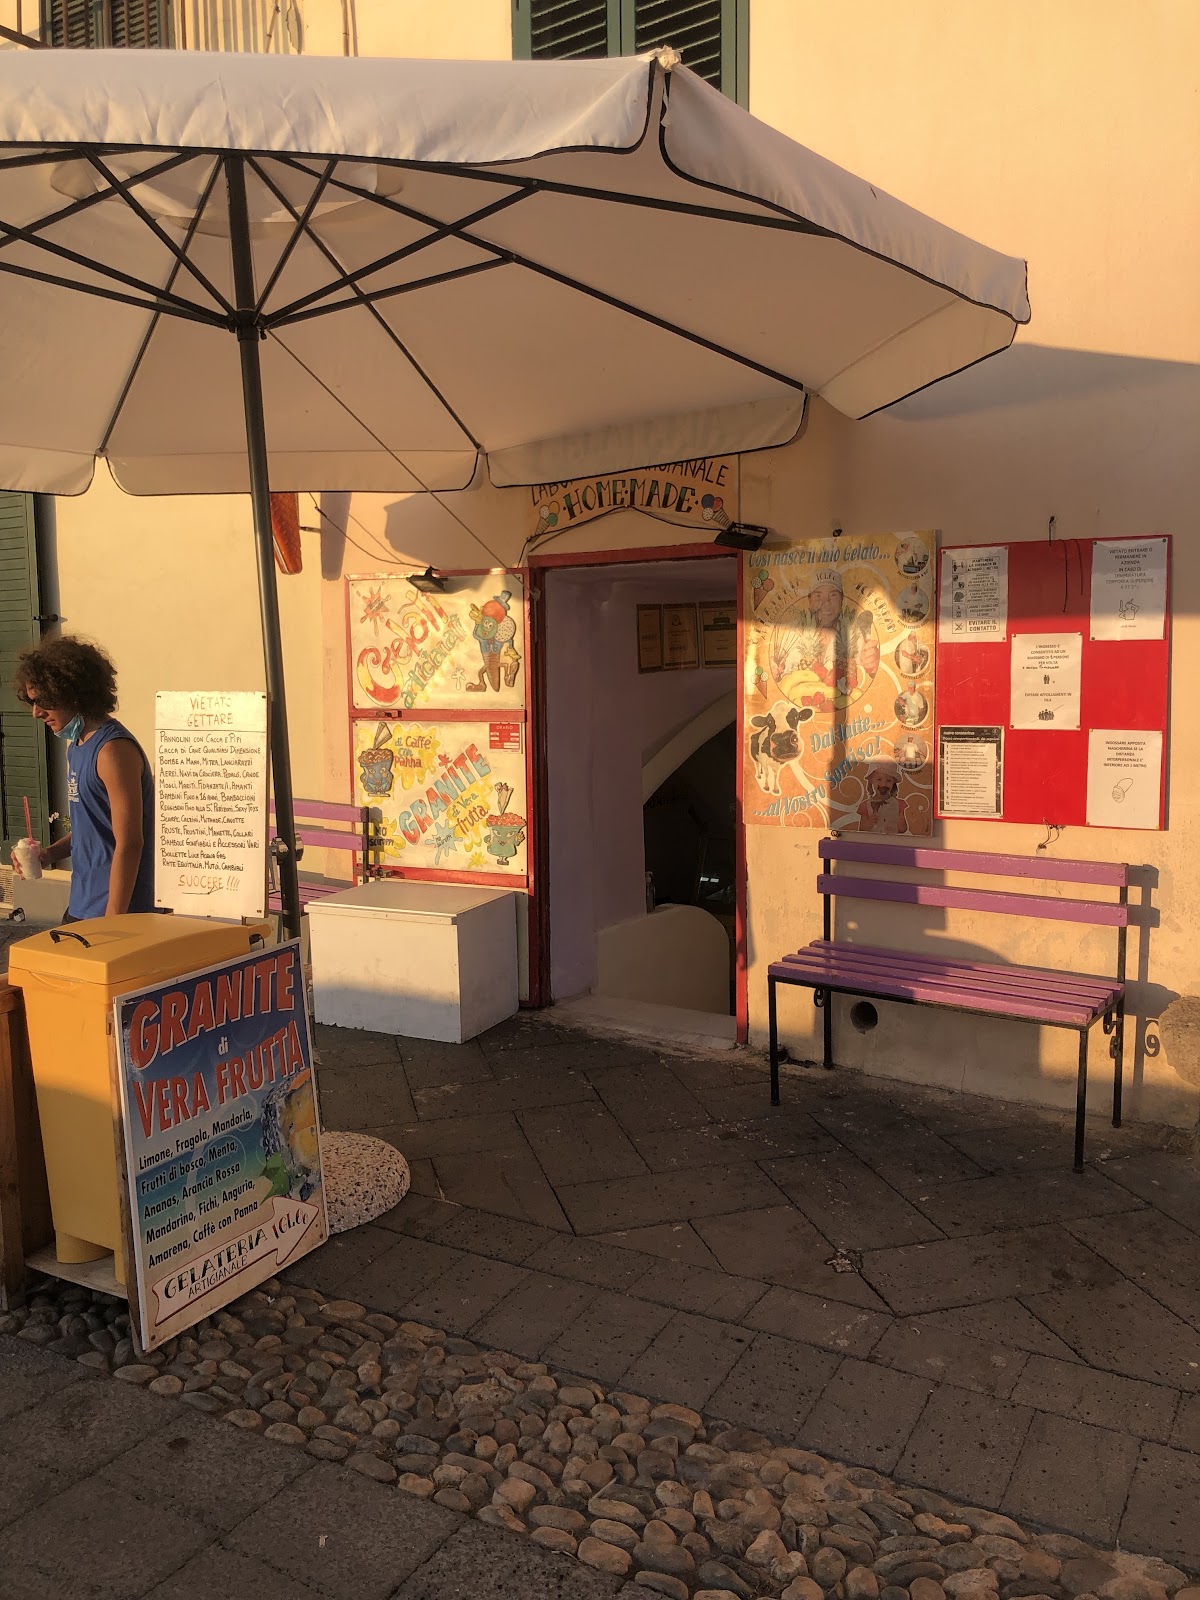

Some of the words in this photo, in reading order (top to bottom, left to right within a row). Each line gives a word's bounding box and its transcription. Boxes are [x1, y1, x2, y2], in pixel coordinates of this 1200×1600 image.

[819, 546, 840, 563] mio
[187, 713, 233, 727] GETTARE
[810, 726, 836, 753] Dal
[200, 793, 206, 801] 16
[399, 744, 491, 845] GRANITE
[178, 875, 224, 889] SUOCERE
[129, 952, 294, 1070] GRANITE
[218, 1037, 229, 1056] di
[133, 1072, 212, 1140] VERA
[215, 1020, 305, 1106] FRUTTA
[139, 1148, 173, 1170] Limone,
[176, 1129, 210, 1153] Fragola,
[212, 1109, 253, 1134] Mandorla,
[141, 1171, 166, 1195] Frutti
[169, 1166, 177, 1181] di
[179, 1157, 206, 1176] bosco,
[208, 1141, 238, 1162] Menta,
[144, 1194, 180, 1220] Ananas,
[182, 1175, 213, 1199] Arancia
[216, 1163, 240, 1181] Rossa
[146, 1210, 196, 1245] Mandarino,
[198, 1195, 220, 1216] Fichi,
[222, 1179, 256, 1204] Anguria,
[149, 1238, 191, 1269] Amarena,
[193, 1222, 216, 1243] Caffè
[218, 1215, 232, 1229] con
[234, 1201, 258, 1220] Panna
[164, 1228, 268, 1299] GELATERIA
[188, 1254, 248, 1298] ARTIGIANALE
